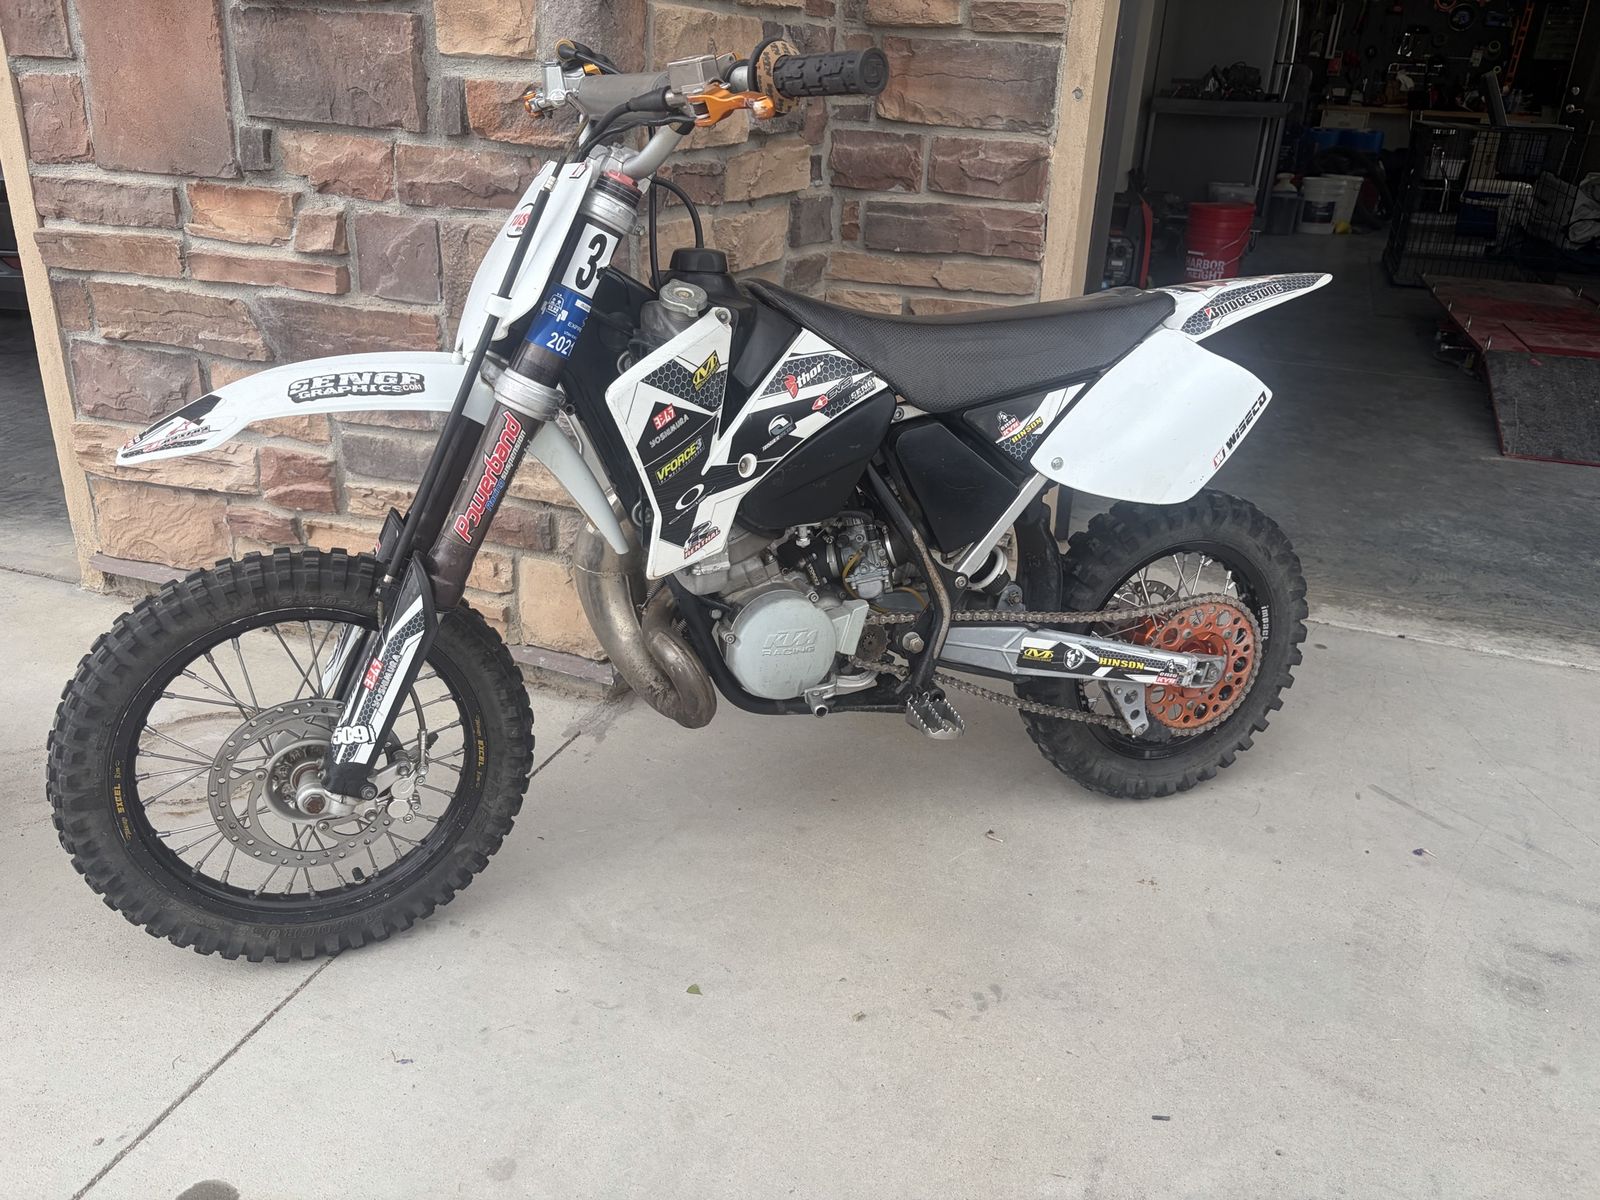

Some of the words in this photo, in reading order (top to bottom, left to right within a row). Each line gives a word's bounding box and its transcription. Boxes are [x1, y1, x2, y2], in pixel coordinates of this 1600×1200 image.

[1185, 256, 1224, 272] HARBOR
[1205, 284, 1282, 320] BRIDGESTONE
[649, 414, 689, 448] YOSHIMURA
[501, 429, 526, 480] suspension
[454, 411, 522, 544] Powerband
[762, 646, 815, 657] RACING
[1099, 657, 1145, 670] HINSON
[477, 740, 485, 767] EXCEL
[113, 783, 125, 814] EXCEL
